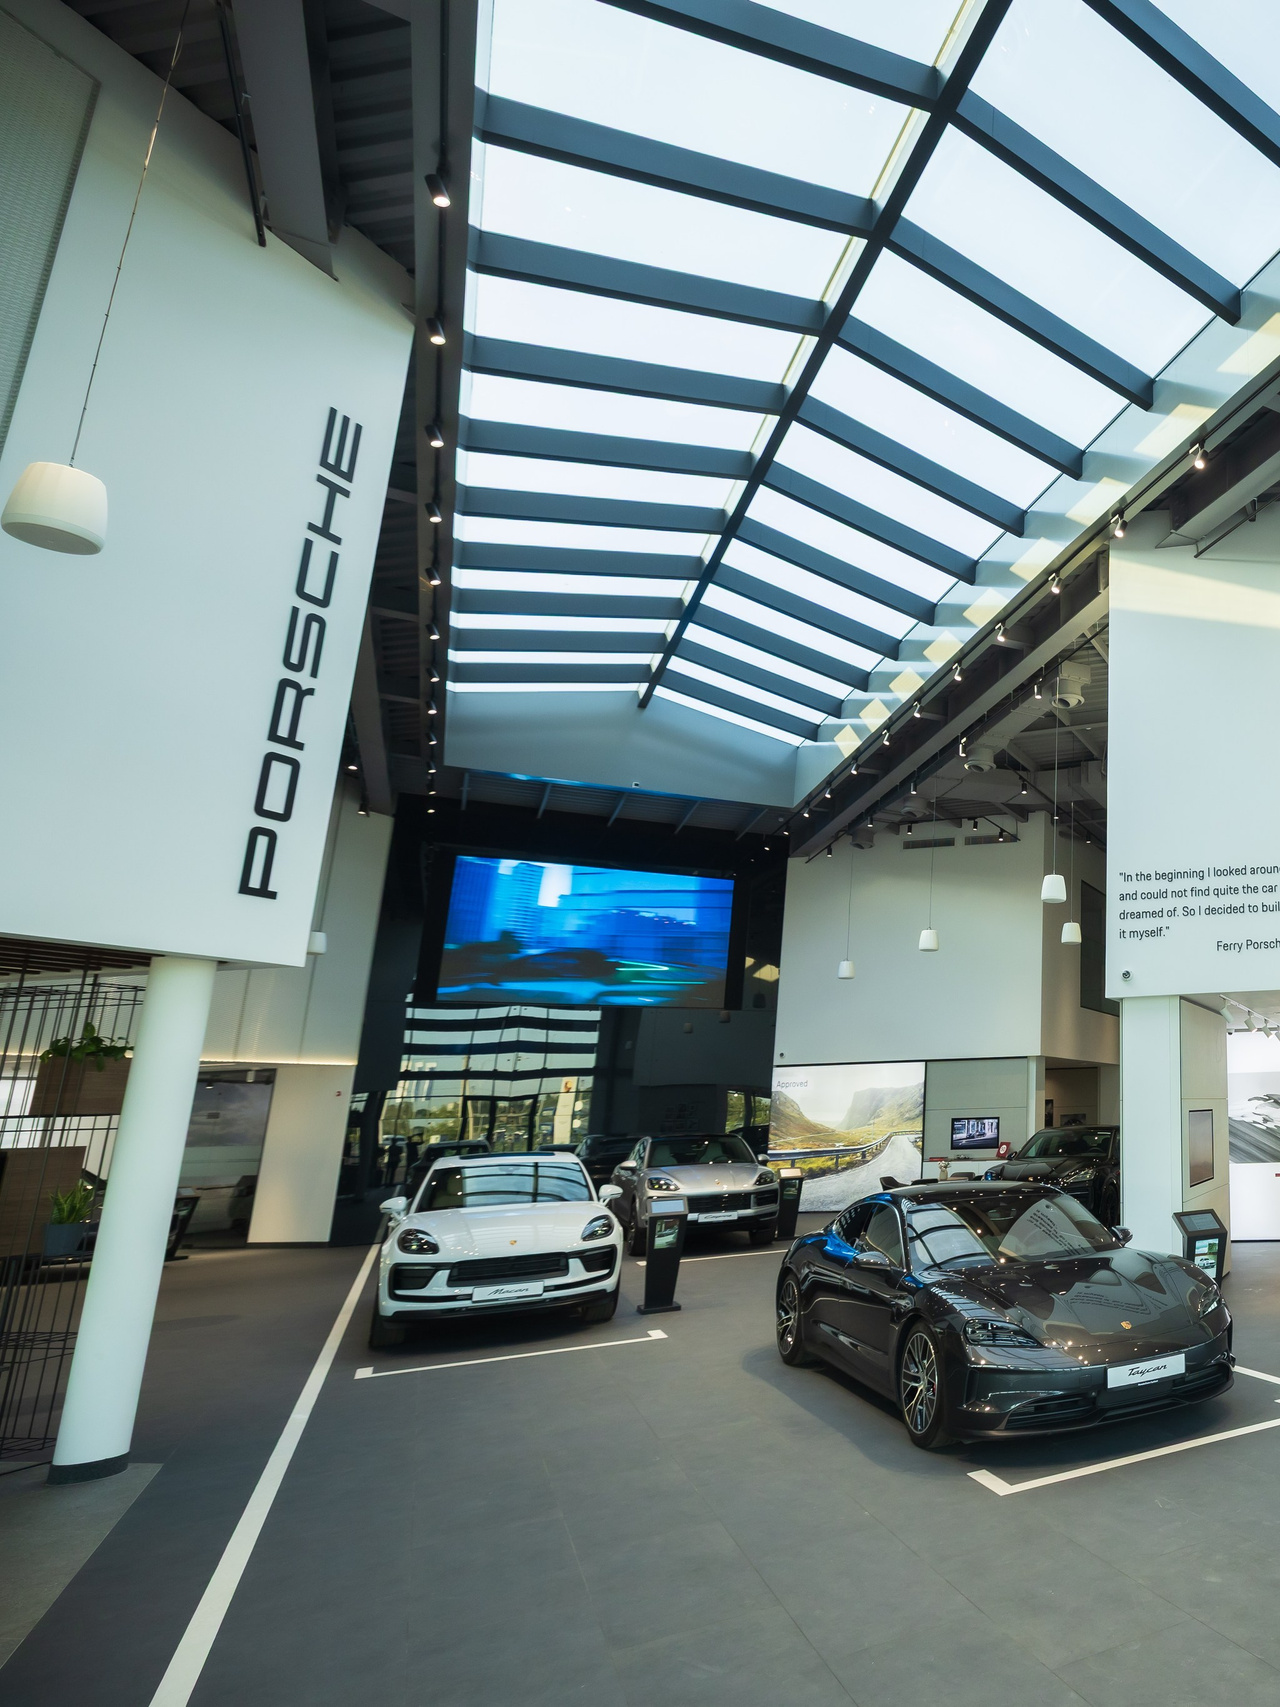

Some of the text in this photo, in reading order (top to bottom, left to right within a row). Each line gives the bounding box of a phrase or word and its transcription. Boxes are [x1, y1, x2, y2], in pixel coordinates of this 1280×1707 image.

[238, 406, 363, 900] PORSCHE
[1119, 872, 1132, 882] "In
[1135, 871, 1152, 881] the
[1154, 868, 1205, 882] beginning
[1213, 865, 1247, 877] looked
[1119, 890, 1137, 901] and
[1140, 889, 1168, 900] could
[1170, 888, 1188, 899] not
[1190, 886, 1210, 897] find
[1212, 885, 1239, 898] quite
[1241, 884, 1259, 894] the
[1261, 884, 1278, 894] car
[1119, 908, 1164, 920] dreamed
[1166, 907, 1180, 918] of.
[1182, 906, 1196, 917] So
[1204, 903, 1245, 916] decided
[1248, 903, 1259, 913] to
[1119, 926, 1170, 940] it myself."
[1216, 940, 1243, 953] Ferry
[776, 1080, 809, 1089] Approved
[488, 1287, 530, 1296] Macan
[1127, 1364, 1168, 1377] Taycan
